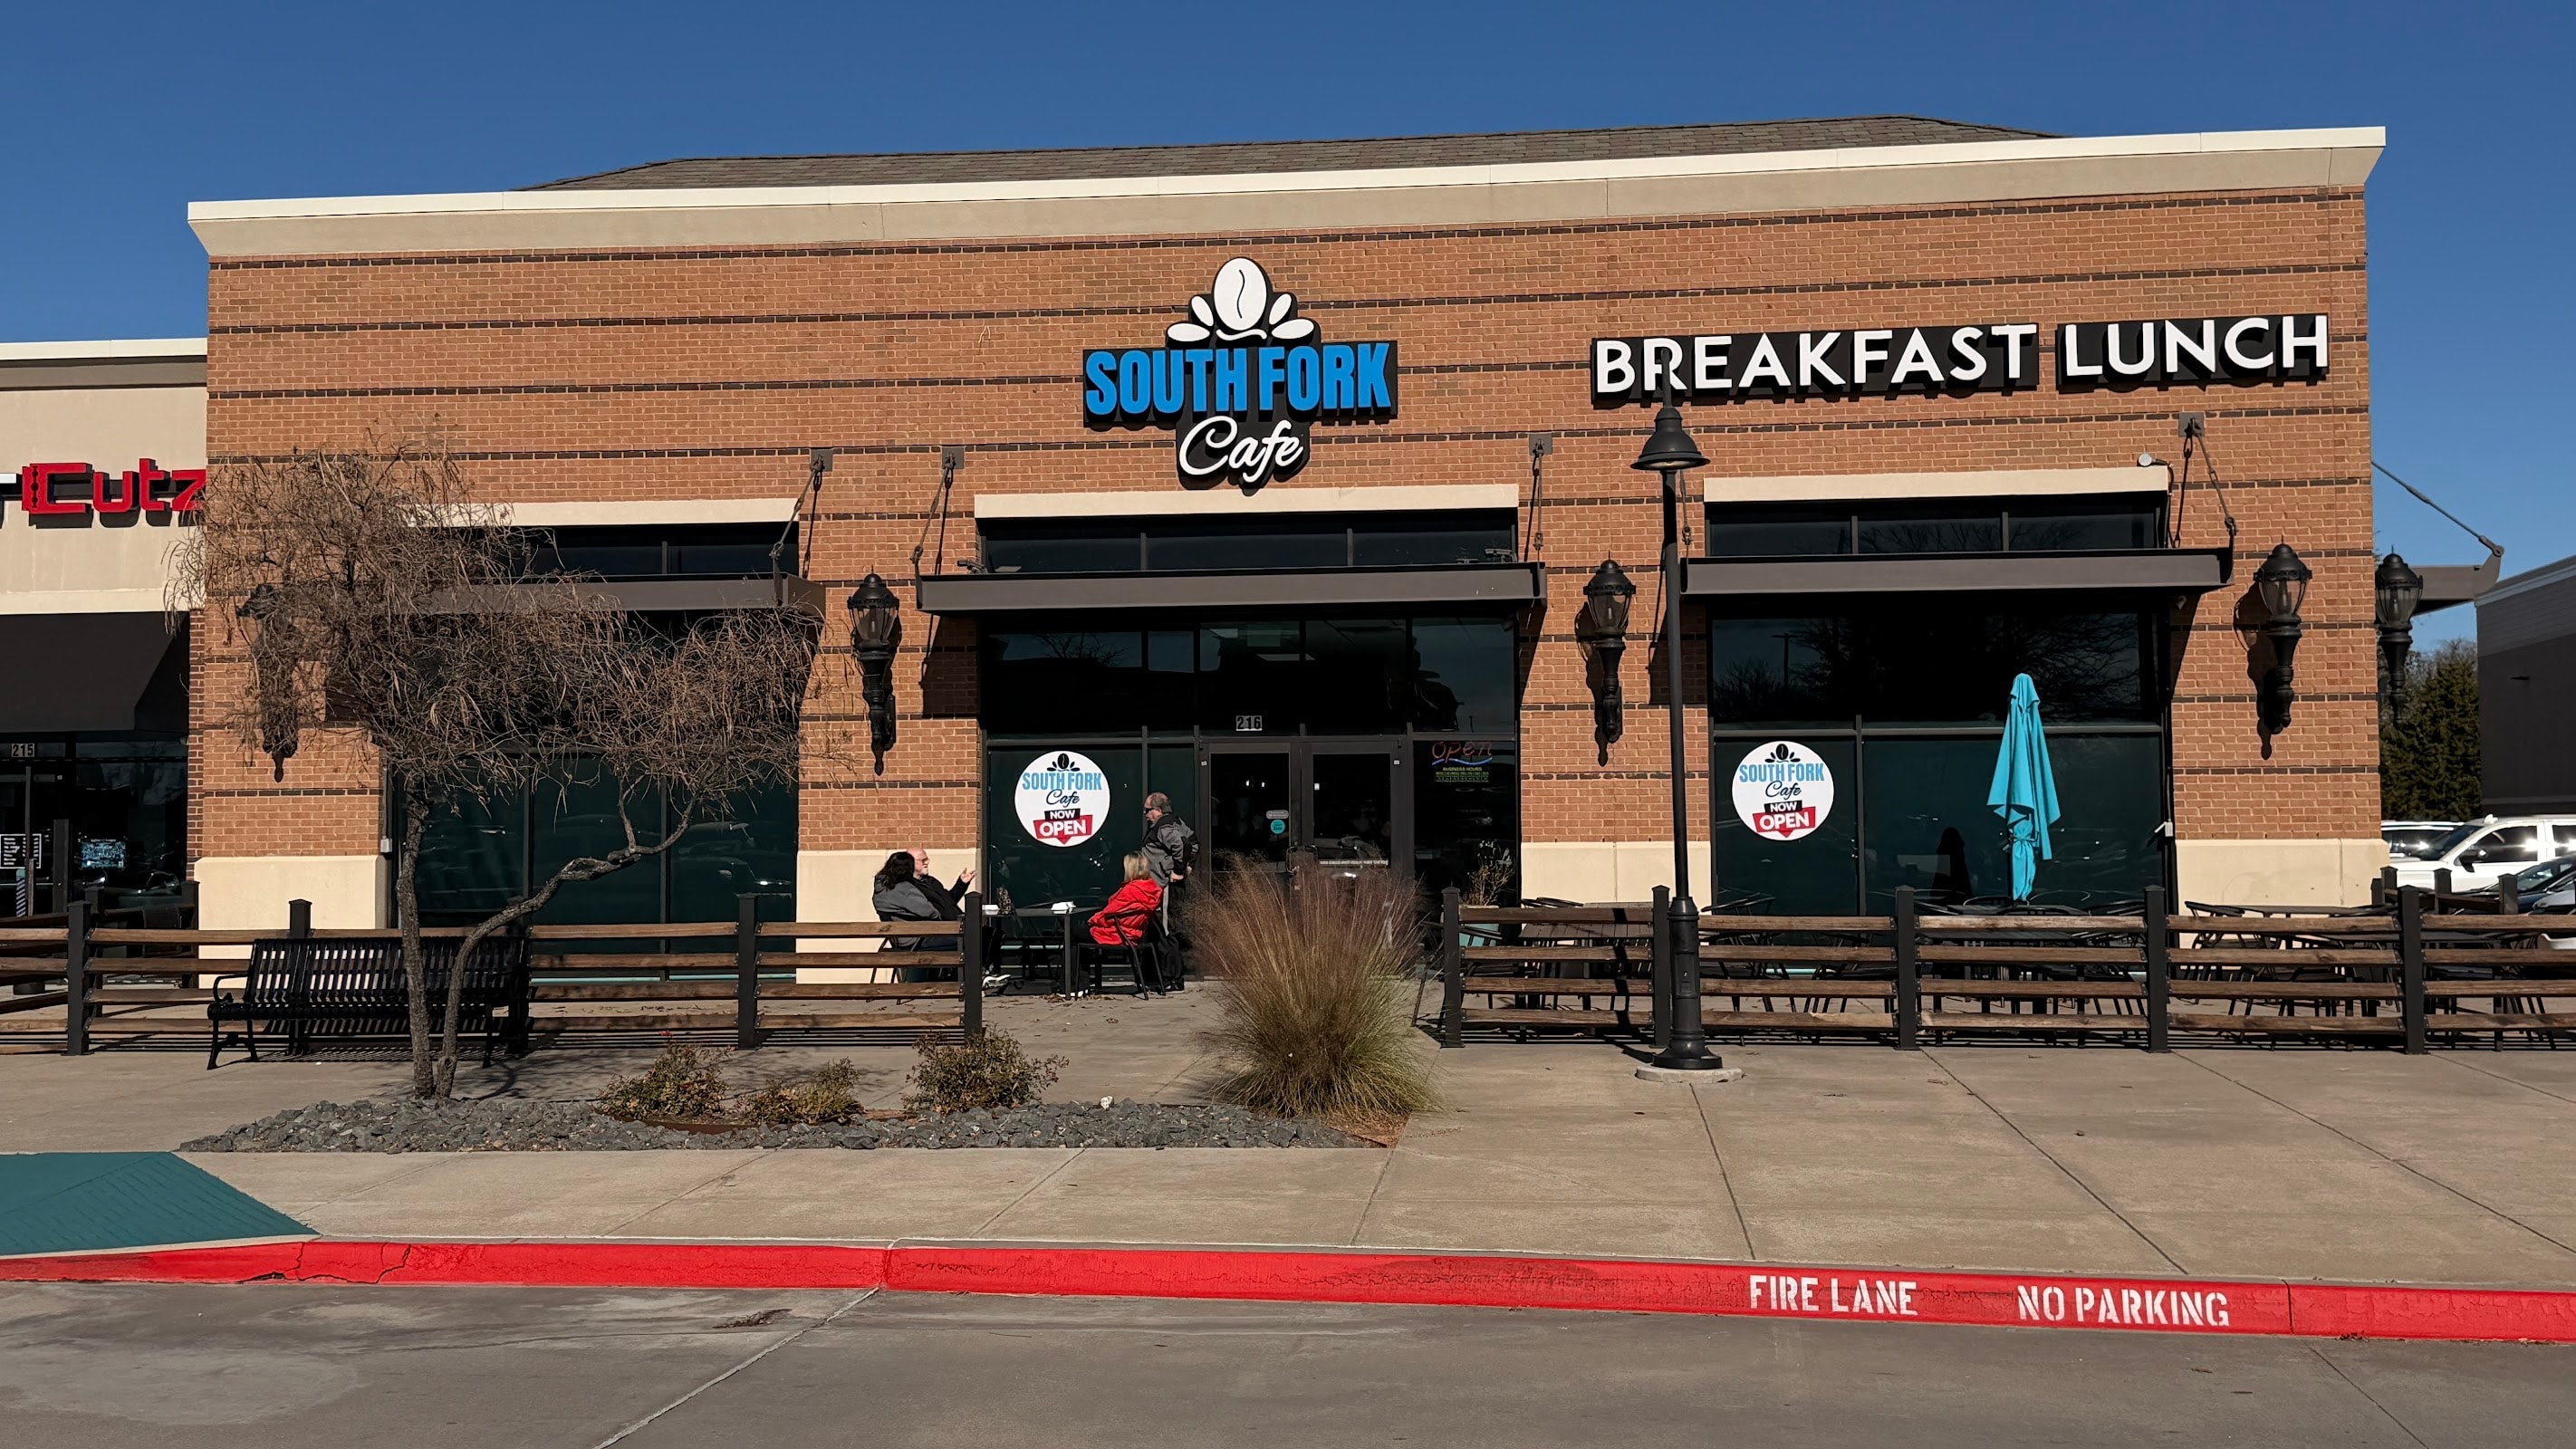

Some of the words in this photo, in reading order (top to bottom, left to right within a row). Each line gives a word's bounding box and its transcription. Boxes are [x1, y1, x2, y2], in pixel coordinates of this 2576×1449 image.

[1596, 323, 2037, 394] BREAKFAST
[2064, 314, 2328, 377] LUNCH
[1086, 347, 1248, 416] SOUTH
[1258, 342, 1392, 412] FORK
[1178, 415, 1304, 483] Cafe
[22, 457, 207, 514] Cutz
[1236, 715, 1262, 730] 216
[12, 744, 34, 757] 215
[1022, 772, 1065, 791] SOUTH
[1068, 772, 1102, 791] FORK
[1739, 763, 1785, 782] SOUTH
[1788, 763, 1825, 782] FORK
[1045, 788, 1081, 808] Cafe
[1764, 780, 1802, 801] Cafe
[1049, 810, 1076, 820] NOW
[1769, 801, 1798, 813] NOW
[1039, 819, 1087, 837] OPEN
[1759, 811, 1810, 830] OPEN
[1748, 1274, 1820, 1312] FIRE
[1831, 1277, 1919, 1316] LANE
[2016, 1284, 2065, 1322] NO
[2076, 1287, 2230, 1327] PARKING
